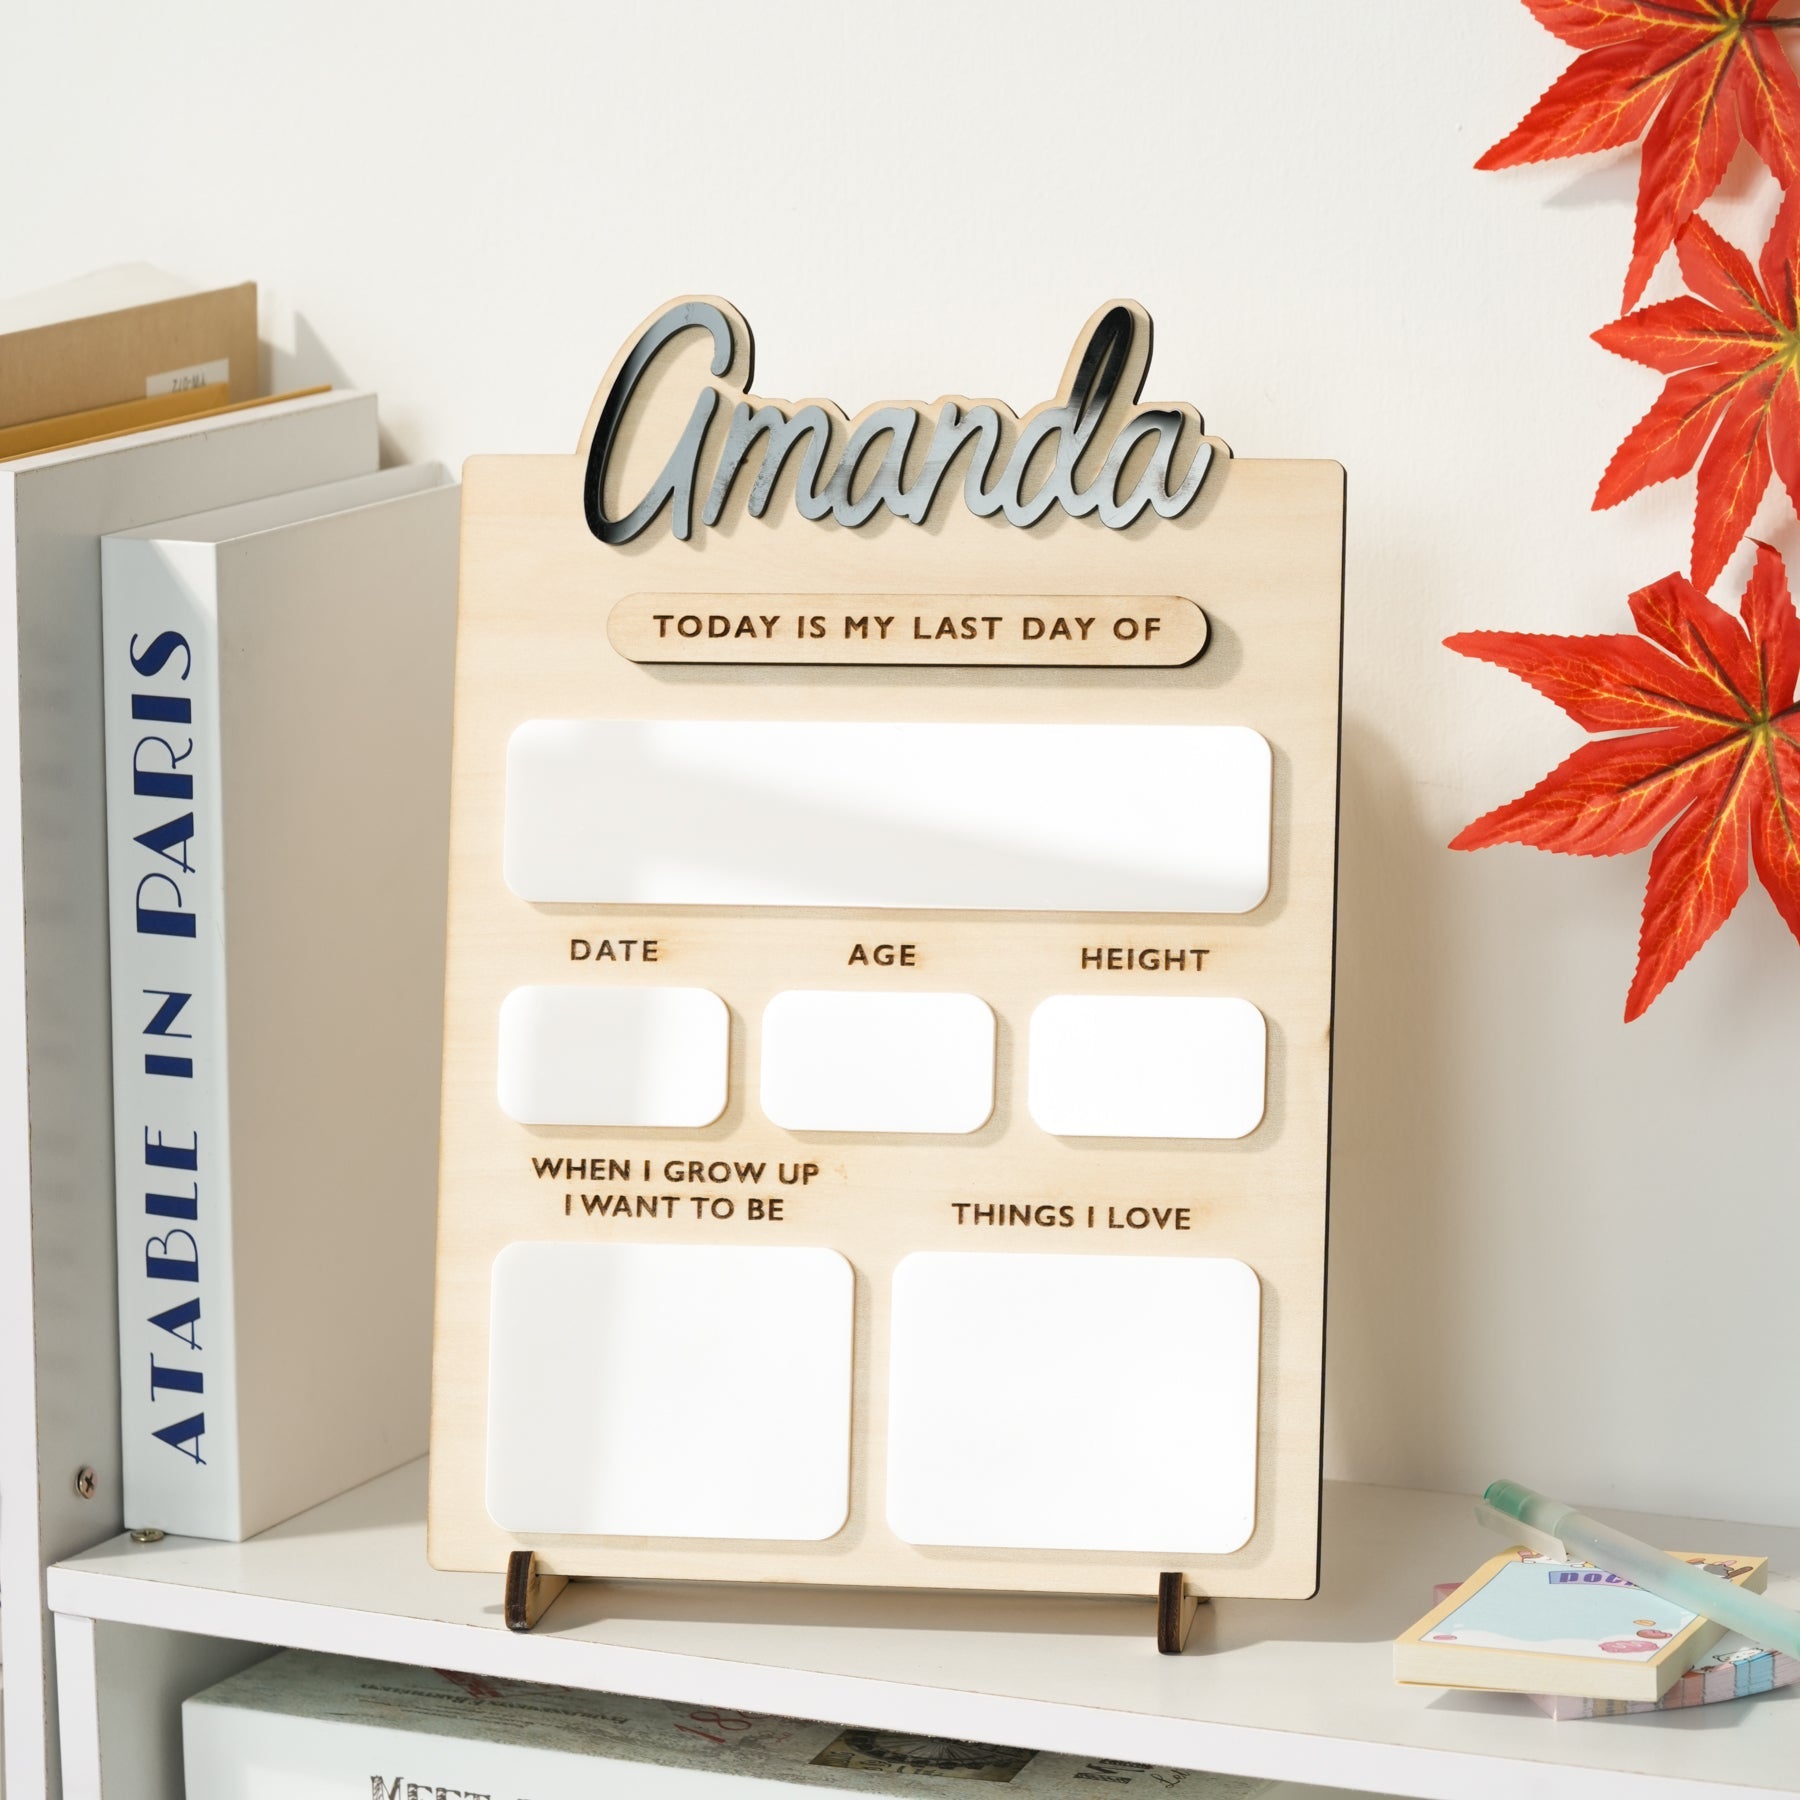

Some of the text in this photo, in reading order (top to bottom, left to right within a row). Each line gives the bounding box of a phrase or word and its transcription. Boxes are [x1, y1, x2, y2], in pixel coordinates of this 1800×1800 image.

[583, 302, 1213, 545] Amanda
[652, 614, 1161, 642] TODAY IS MY LAST DAY OF
[129, 629, 199, 940] PARIS
[570, 938, 658, 963] DATE
[848, 943, 917, 968] AGE
[1081, 947, 1211, 973] HEIGHT
[142, 988, 197, 1080] IN
[531, 1157, 819, 1186] WHEN I GROW UP
[565, 1193, 784, 1222] I WANT TO BE
[951, 1202, 1191, 1232] THINGS I LOVE
